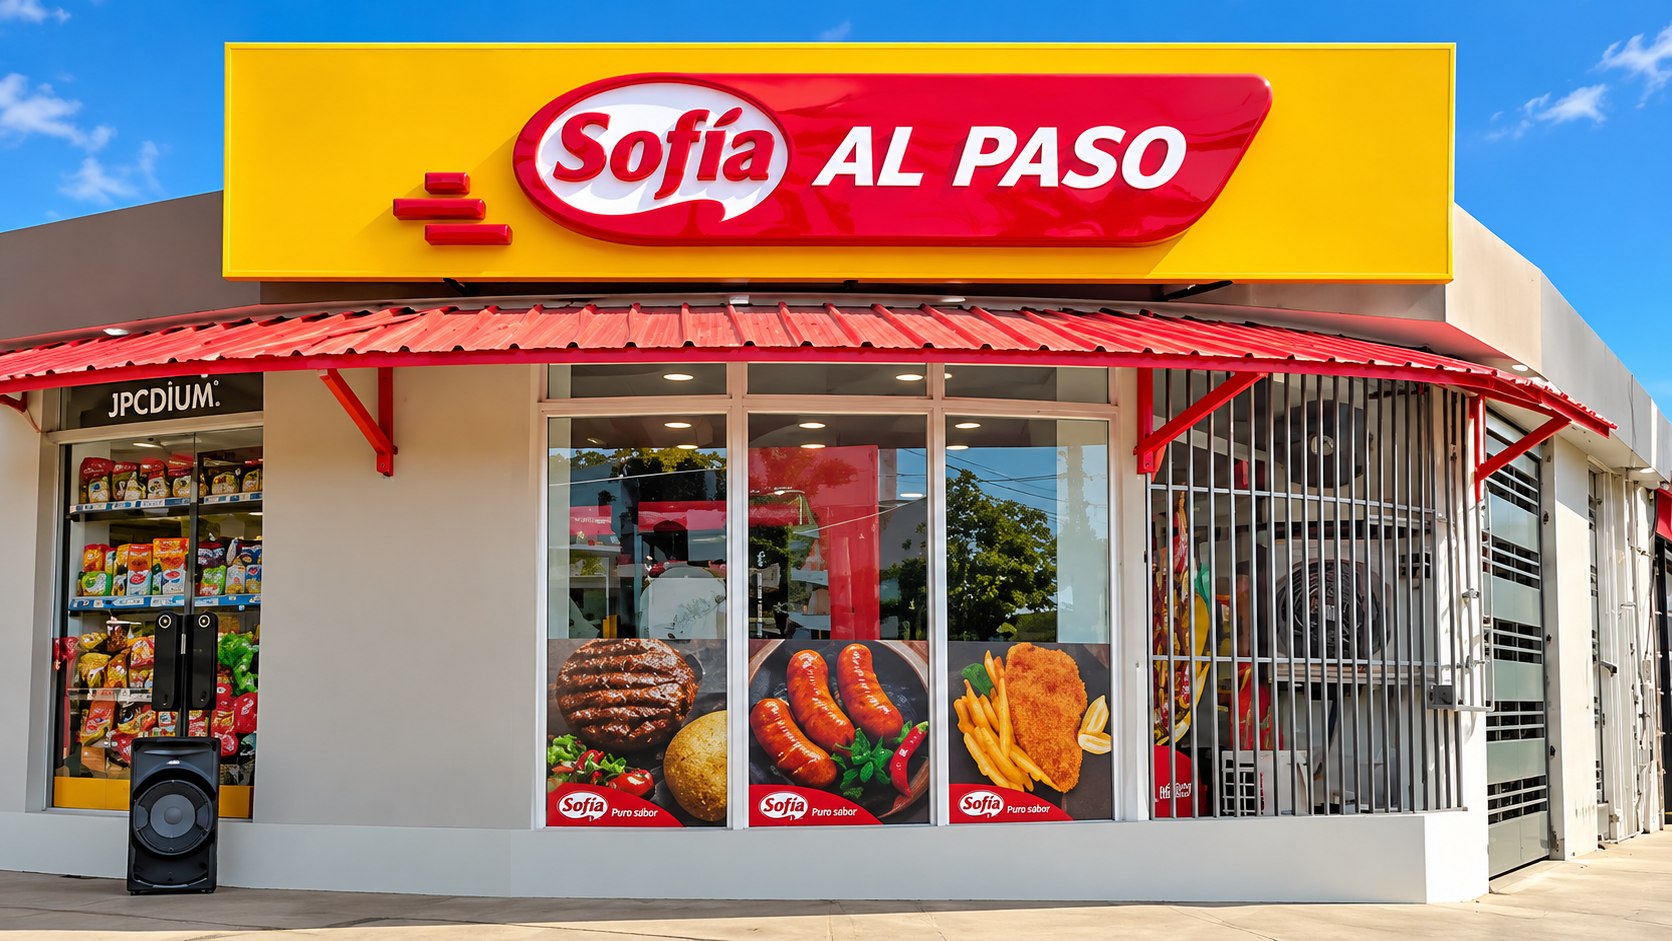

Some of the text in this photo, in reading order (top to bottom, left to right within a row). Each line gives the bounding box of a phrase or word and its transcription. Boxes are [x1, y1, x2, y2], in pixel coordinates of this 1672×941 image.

[552, 106, 1187, 200] Sofía AL PASO
[562, 797, 604, 815] Sofía
[611, 808, 632, 817] Puro
[763, 797, 804, 815] Sofía
[811, 806, 857, 816] Puro sabor
[962, 795, 1000, 813] Sofía
[1006, 804, 1051, 814] Puro sabor
